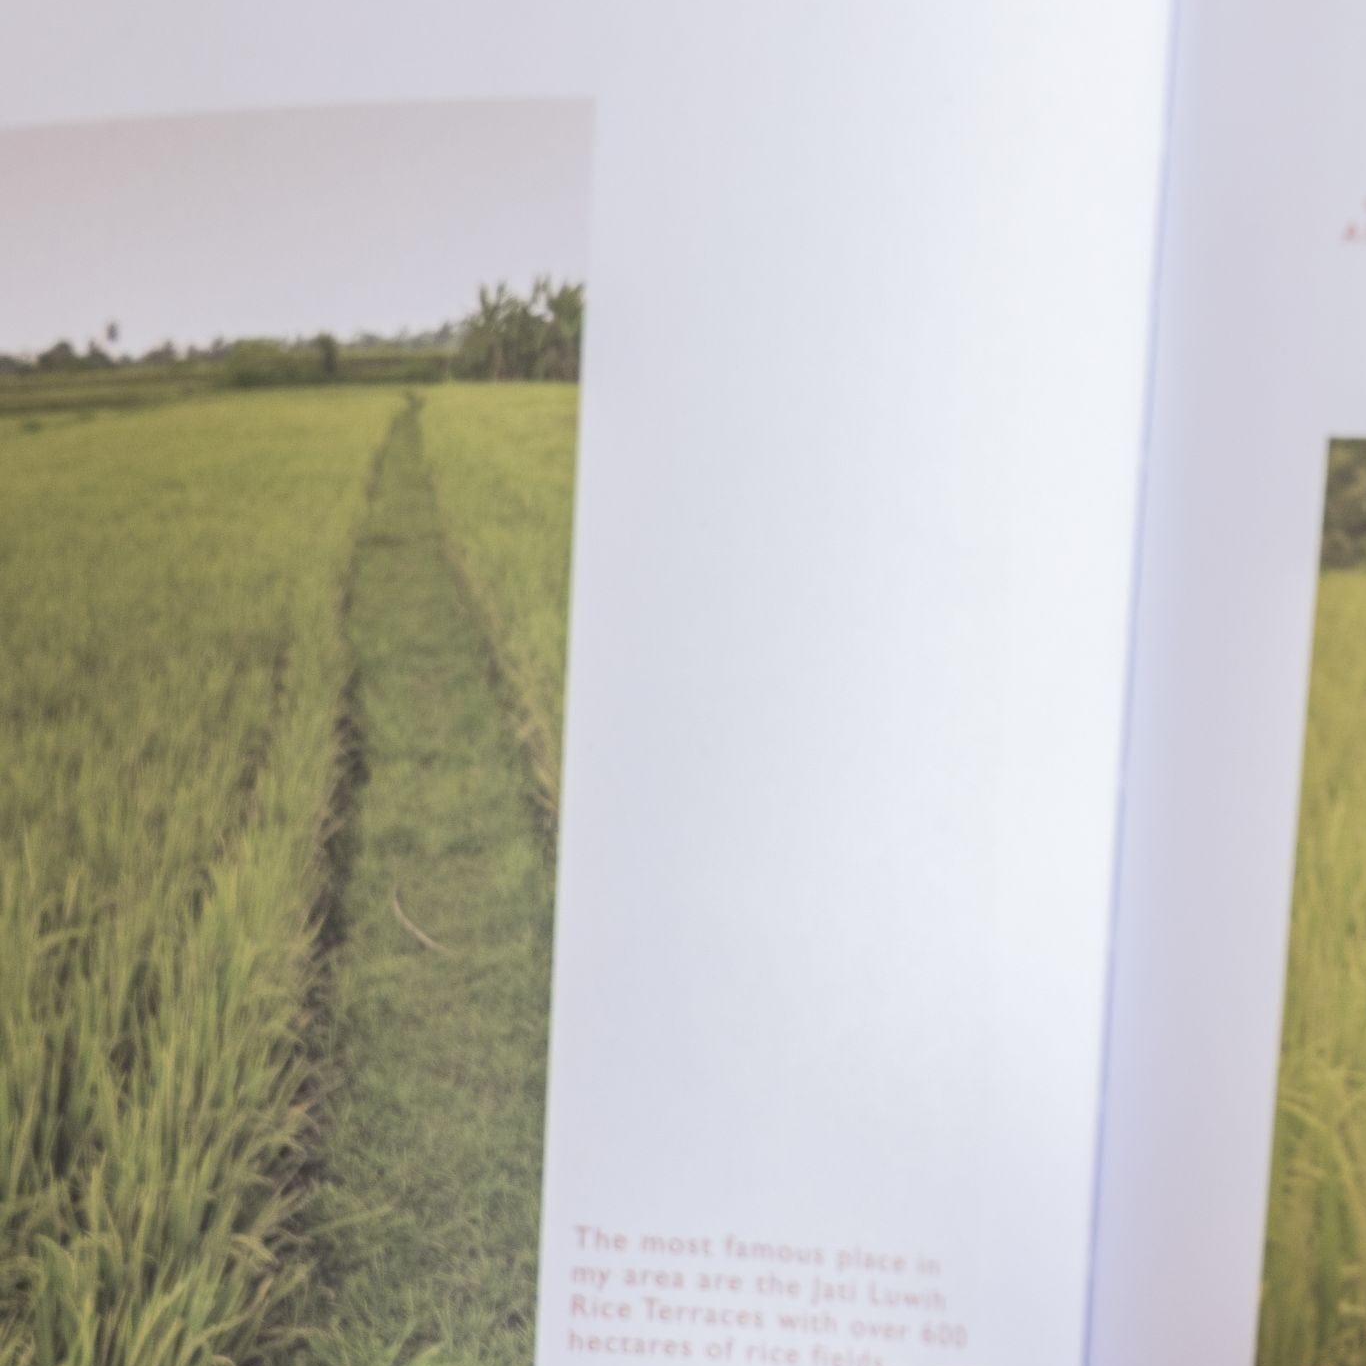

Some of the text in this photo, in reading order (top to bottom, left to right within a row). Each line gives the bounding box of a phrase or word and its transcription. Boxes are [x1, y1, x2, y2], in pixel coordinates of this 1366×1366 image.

[574, 1225, 941, 1276] The most famous place in
[570, 1266, 610, 1291] my
[624, 1268, 684, 1290] area
[698, 1273, 743, 1294] are
[756, 1271, 800, 1299] the
[811, 1278, 857, 1307] Jati
[570, 1294, 632, 1322] Rice
[643, 1297, 765, 1330] Terraces
[777, 1304, 838, 1335] with
[850, 1319, 910, 1343] over
[567, 1329, 692, 1359] hectares
[704, 1338, 736, 1361] of
[746, 1341, 799, 1366] rice
